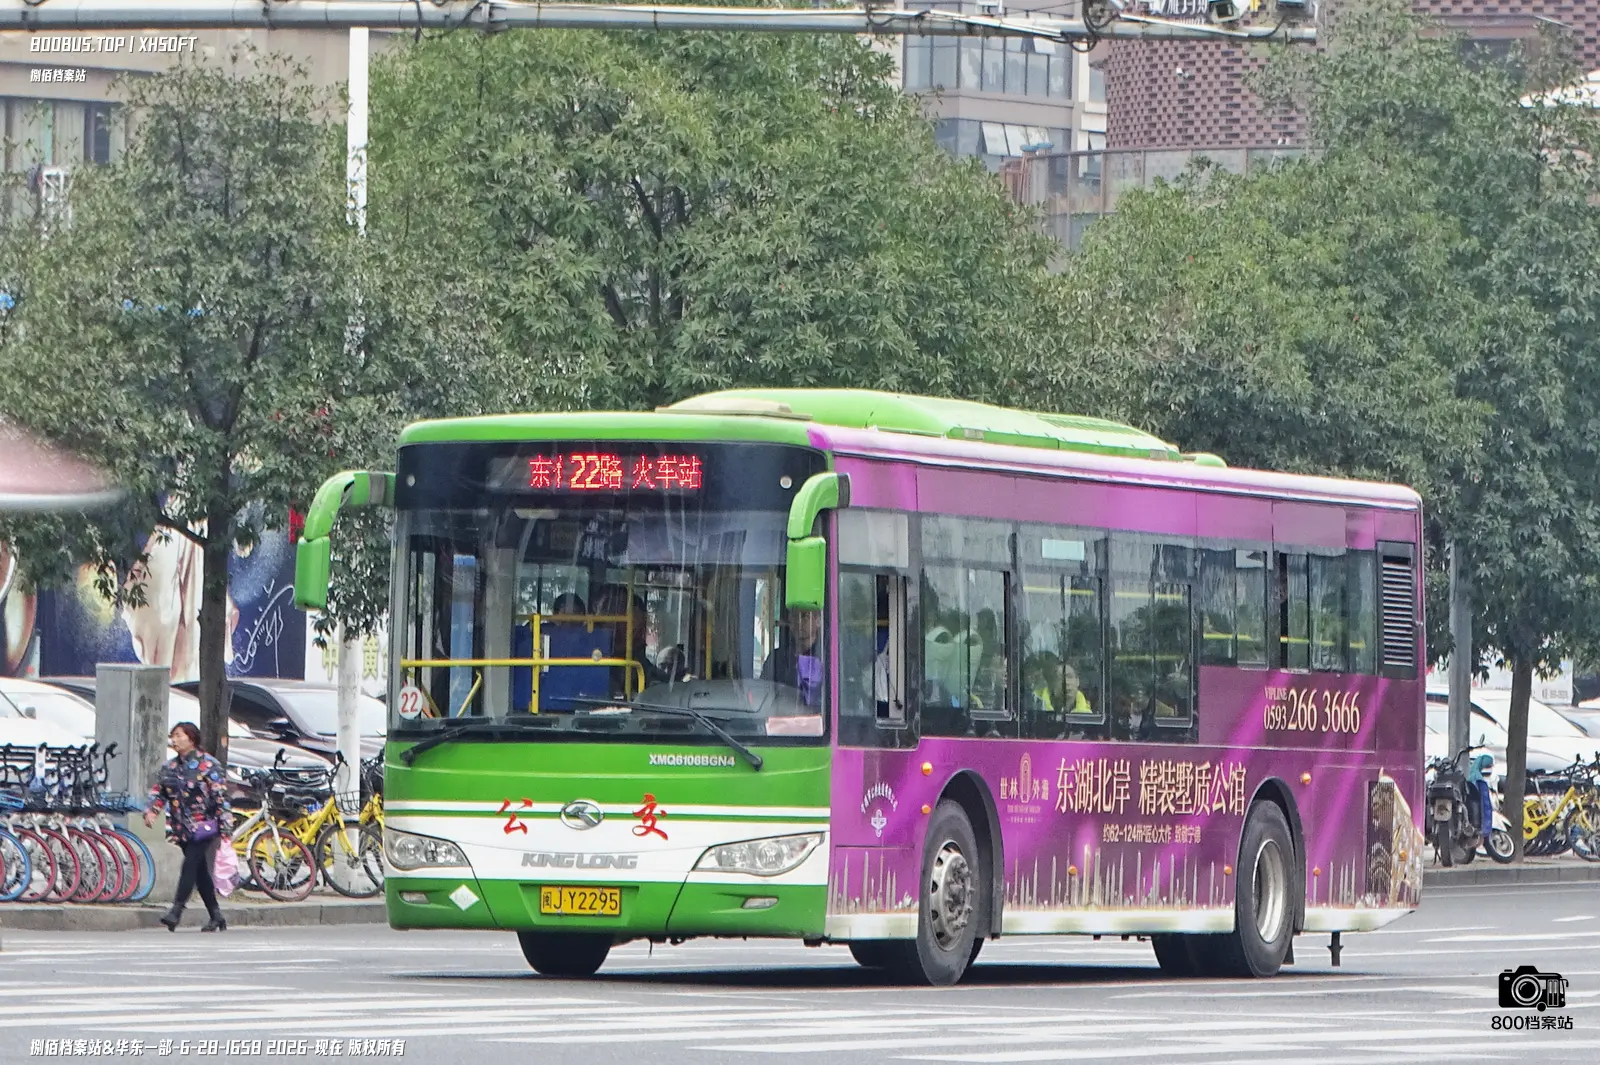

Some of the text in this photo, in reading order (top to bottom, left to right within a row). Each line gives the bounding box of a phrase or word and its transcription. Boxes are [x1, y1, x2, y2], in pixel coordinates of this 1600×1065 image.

[632, 455, 702, 489] 火车站
[401, 692, 418, 712] 22
[1263, 688, 1360, 734] 0593 266 3666
[1055, 757, 1247, 817] 东湖北岸 精装墅质公馆
[495, 793, 669, 841] 公 交
